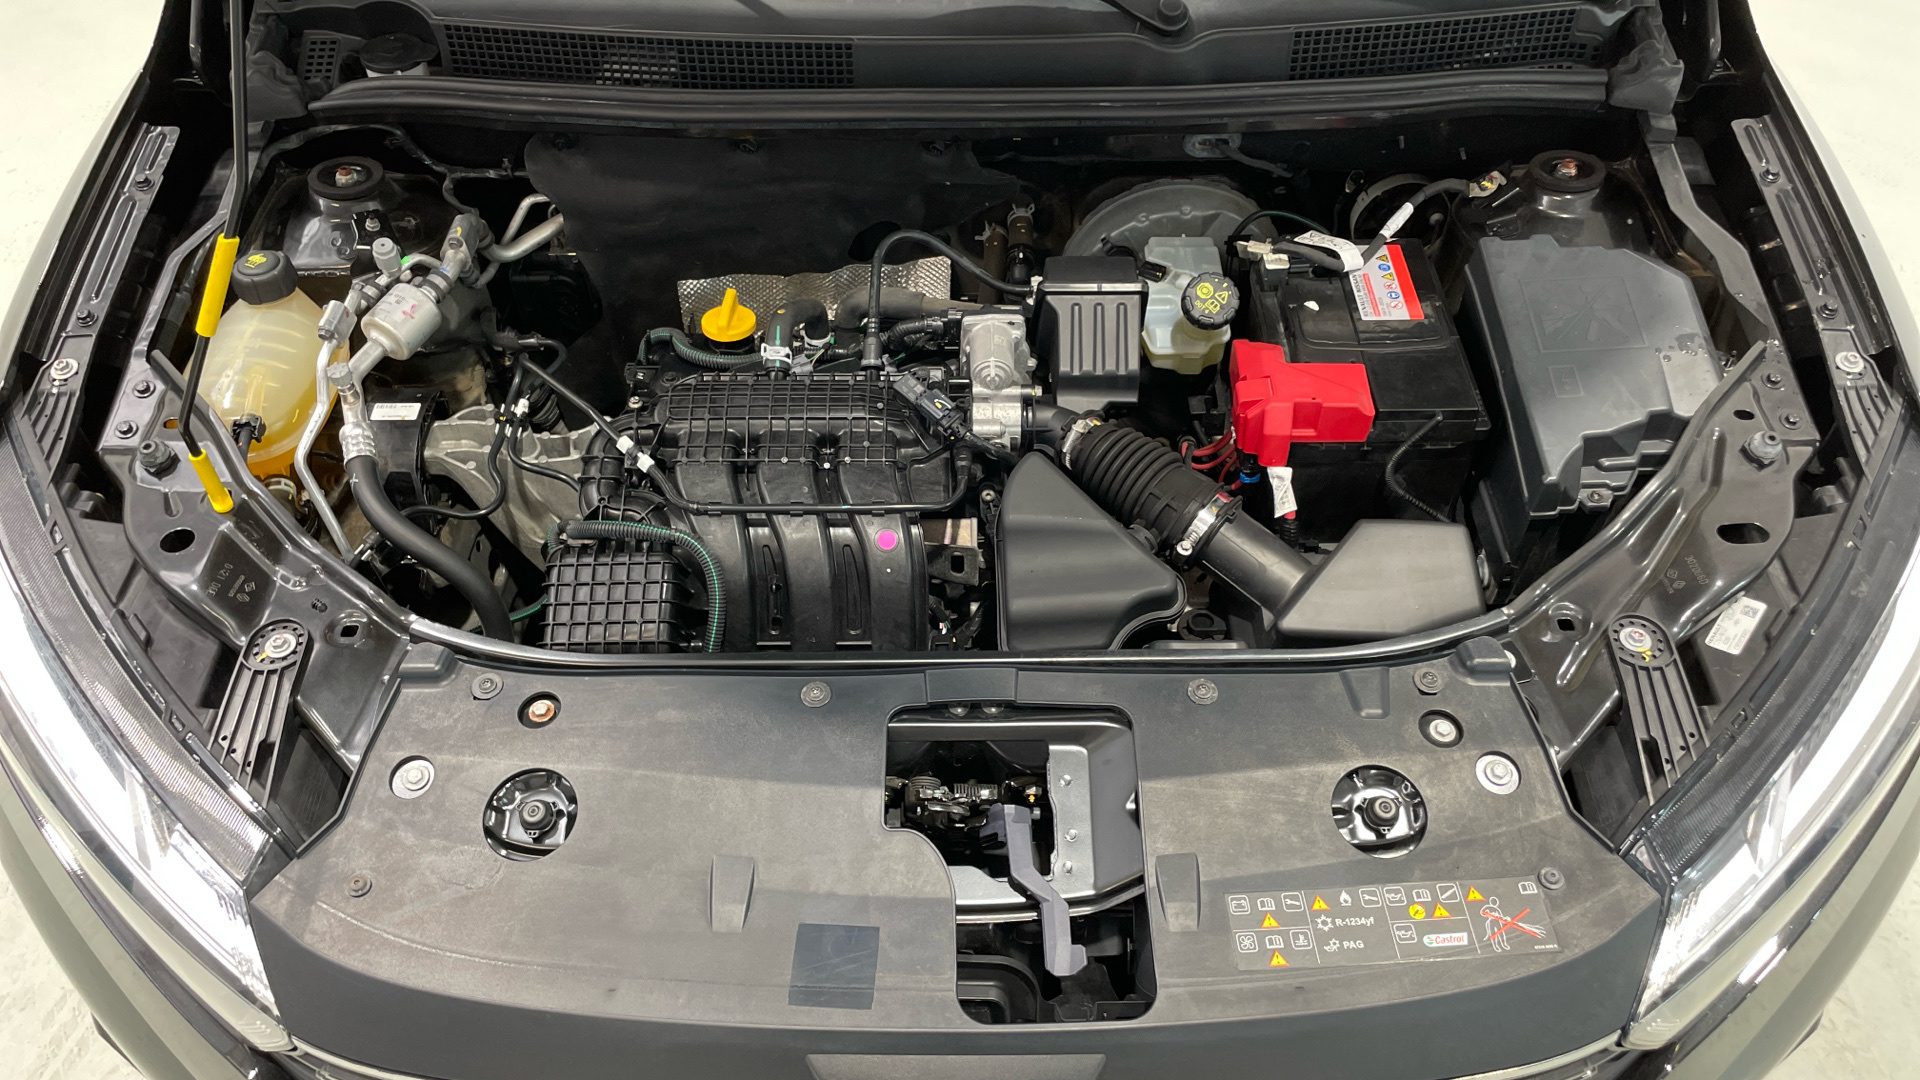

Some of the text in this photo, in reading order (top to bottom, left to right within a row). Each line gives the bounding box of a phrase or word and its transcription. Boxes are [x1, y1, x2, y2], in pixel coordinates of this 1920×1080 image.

[1352, 273, 1362, 293] NISSAN
[1194, 299, 1205, 310] DOT
[1707, 623, 1721, 644] RENAULT
[1335, 916, 1375, 927] R-1234yf
[1342, 940, 1365, 950] PAG
[1435, 934, 1465, 945] Castrol
